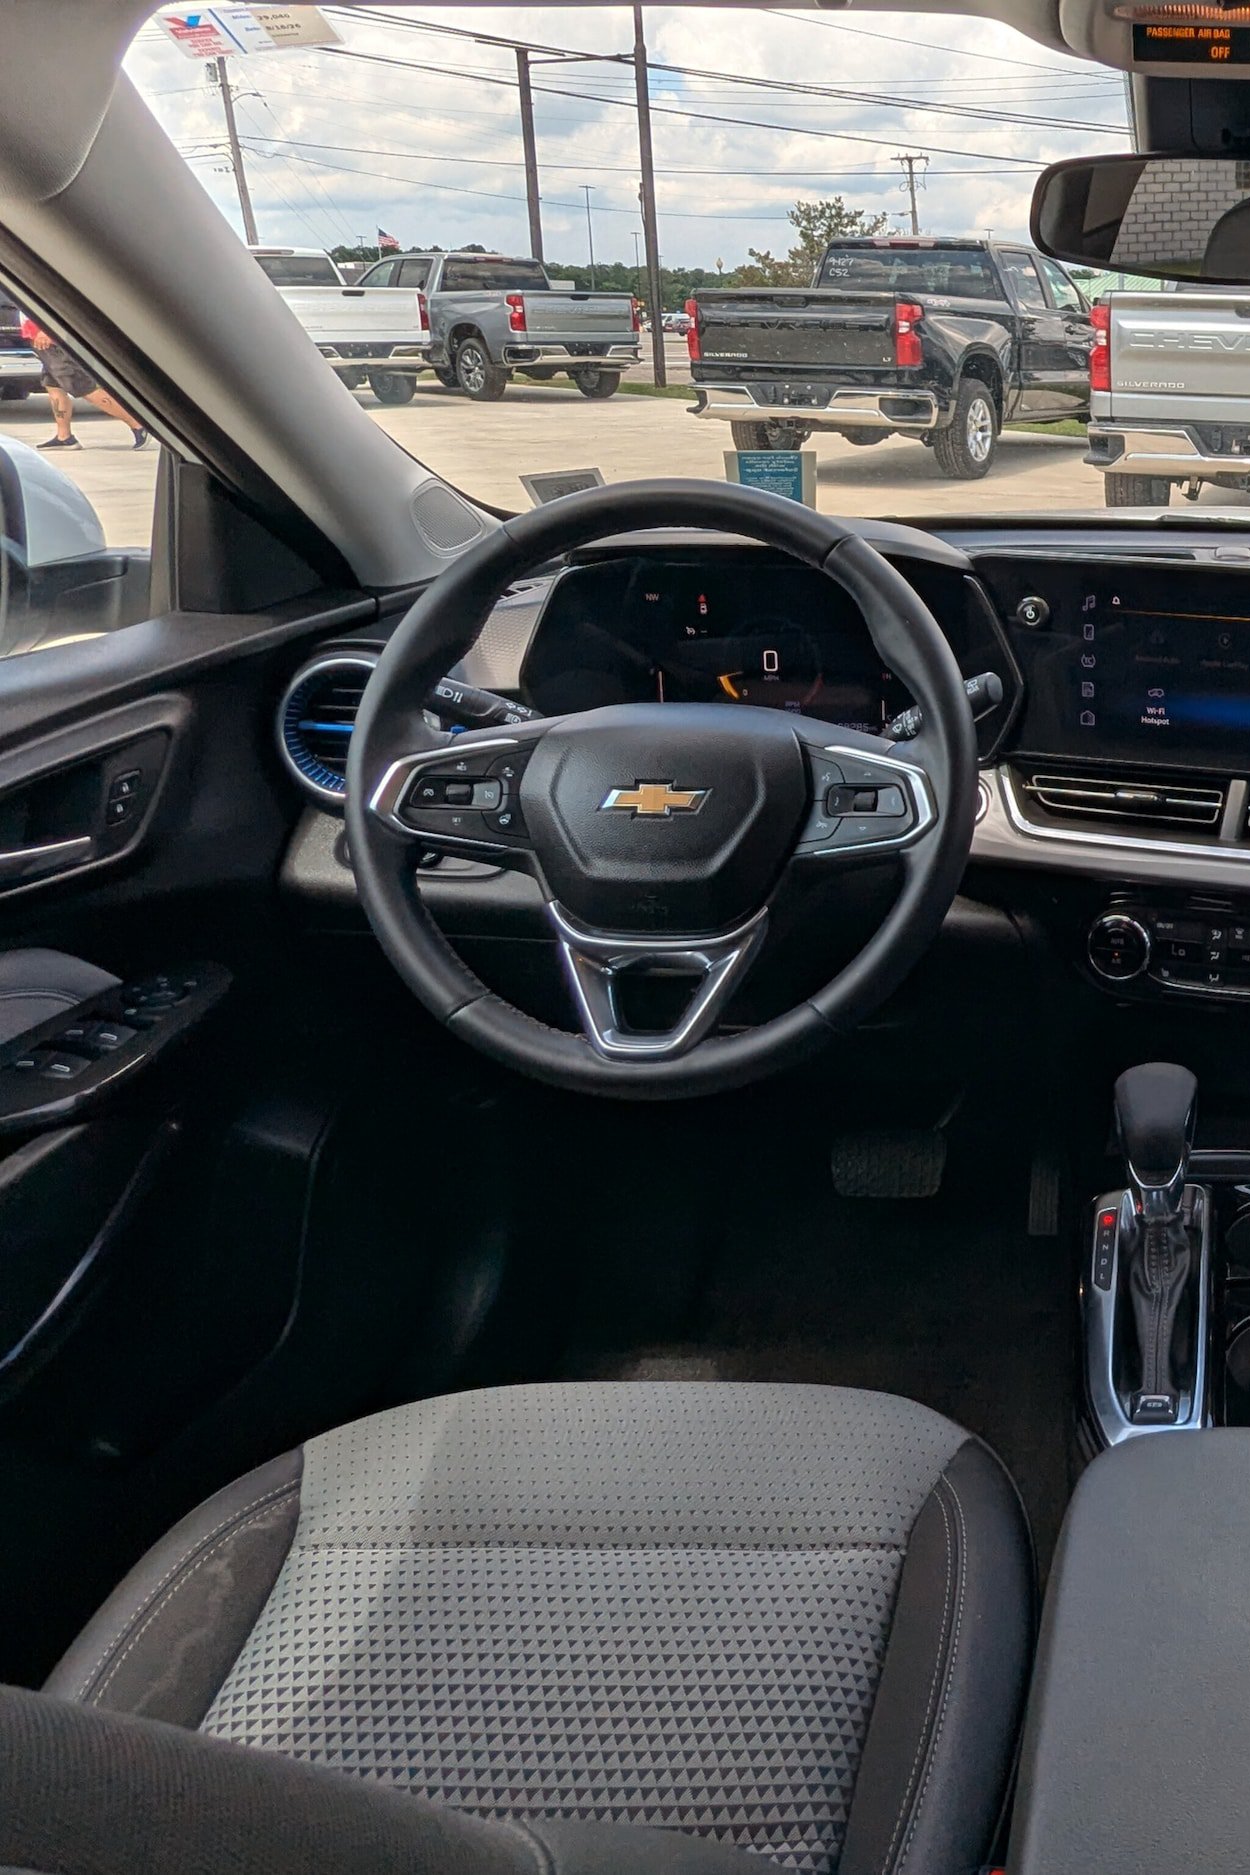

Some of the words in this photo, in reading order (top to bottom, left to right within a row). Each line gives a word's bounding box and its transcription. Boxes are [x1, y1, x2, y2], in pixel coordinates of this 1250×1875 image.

[1146, 26, 1195, 38] PASSENGER
[1211, 46, 1230, 59] OFF
[703, 351, 749, 359] SILVERADO
[1116, 380, 1185, 389] SILVERADO
[763, 650, 779, 672] 0
[1146, 706, 1166, 715] Wi-Fi
[1140, 716, 1170, 726] Hotspot
